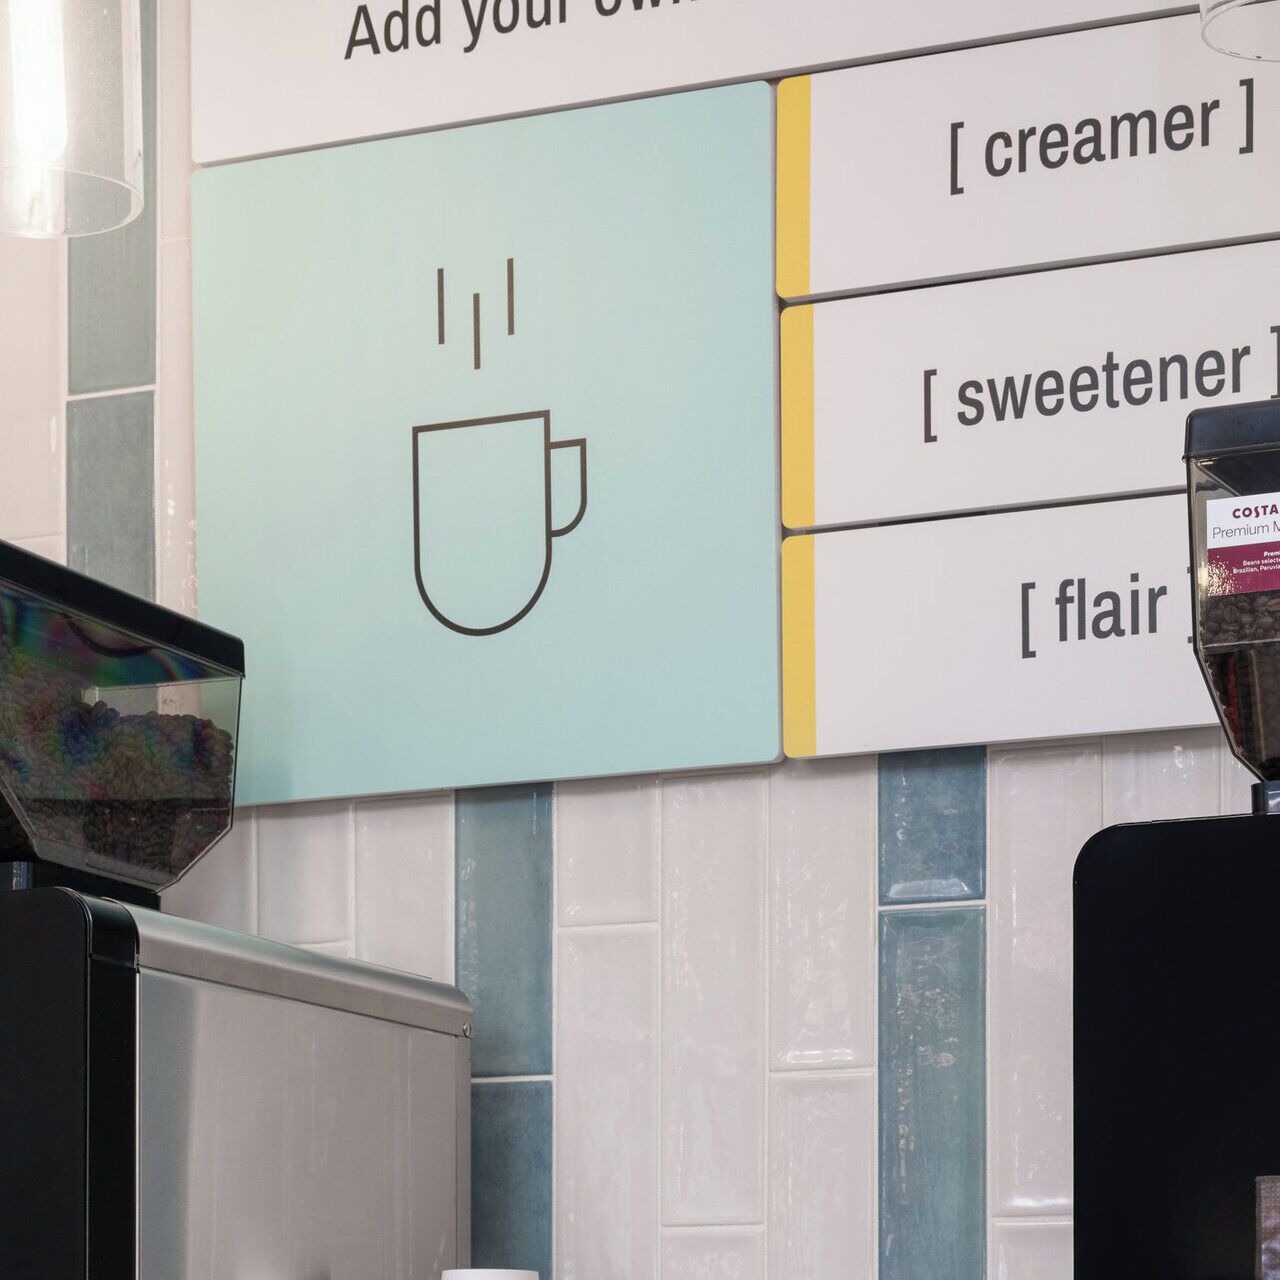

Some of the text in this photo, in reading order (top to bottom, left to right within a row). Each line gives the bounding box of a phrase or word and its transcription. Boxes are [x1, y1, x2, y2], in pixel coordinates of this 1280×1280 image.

[344, 0, 441, 60] Add
[984, 99, 1220, 177] creamer
[957, 345, 1251, 426] sweetener
[1212, 524, 1270, 539] Premium
[1232, 504, 1279, 519] COSTA
[1055, 572, 1167, 642] flair
